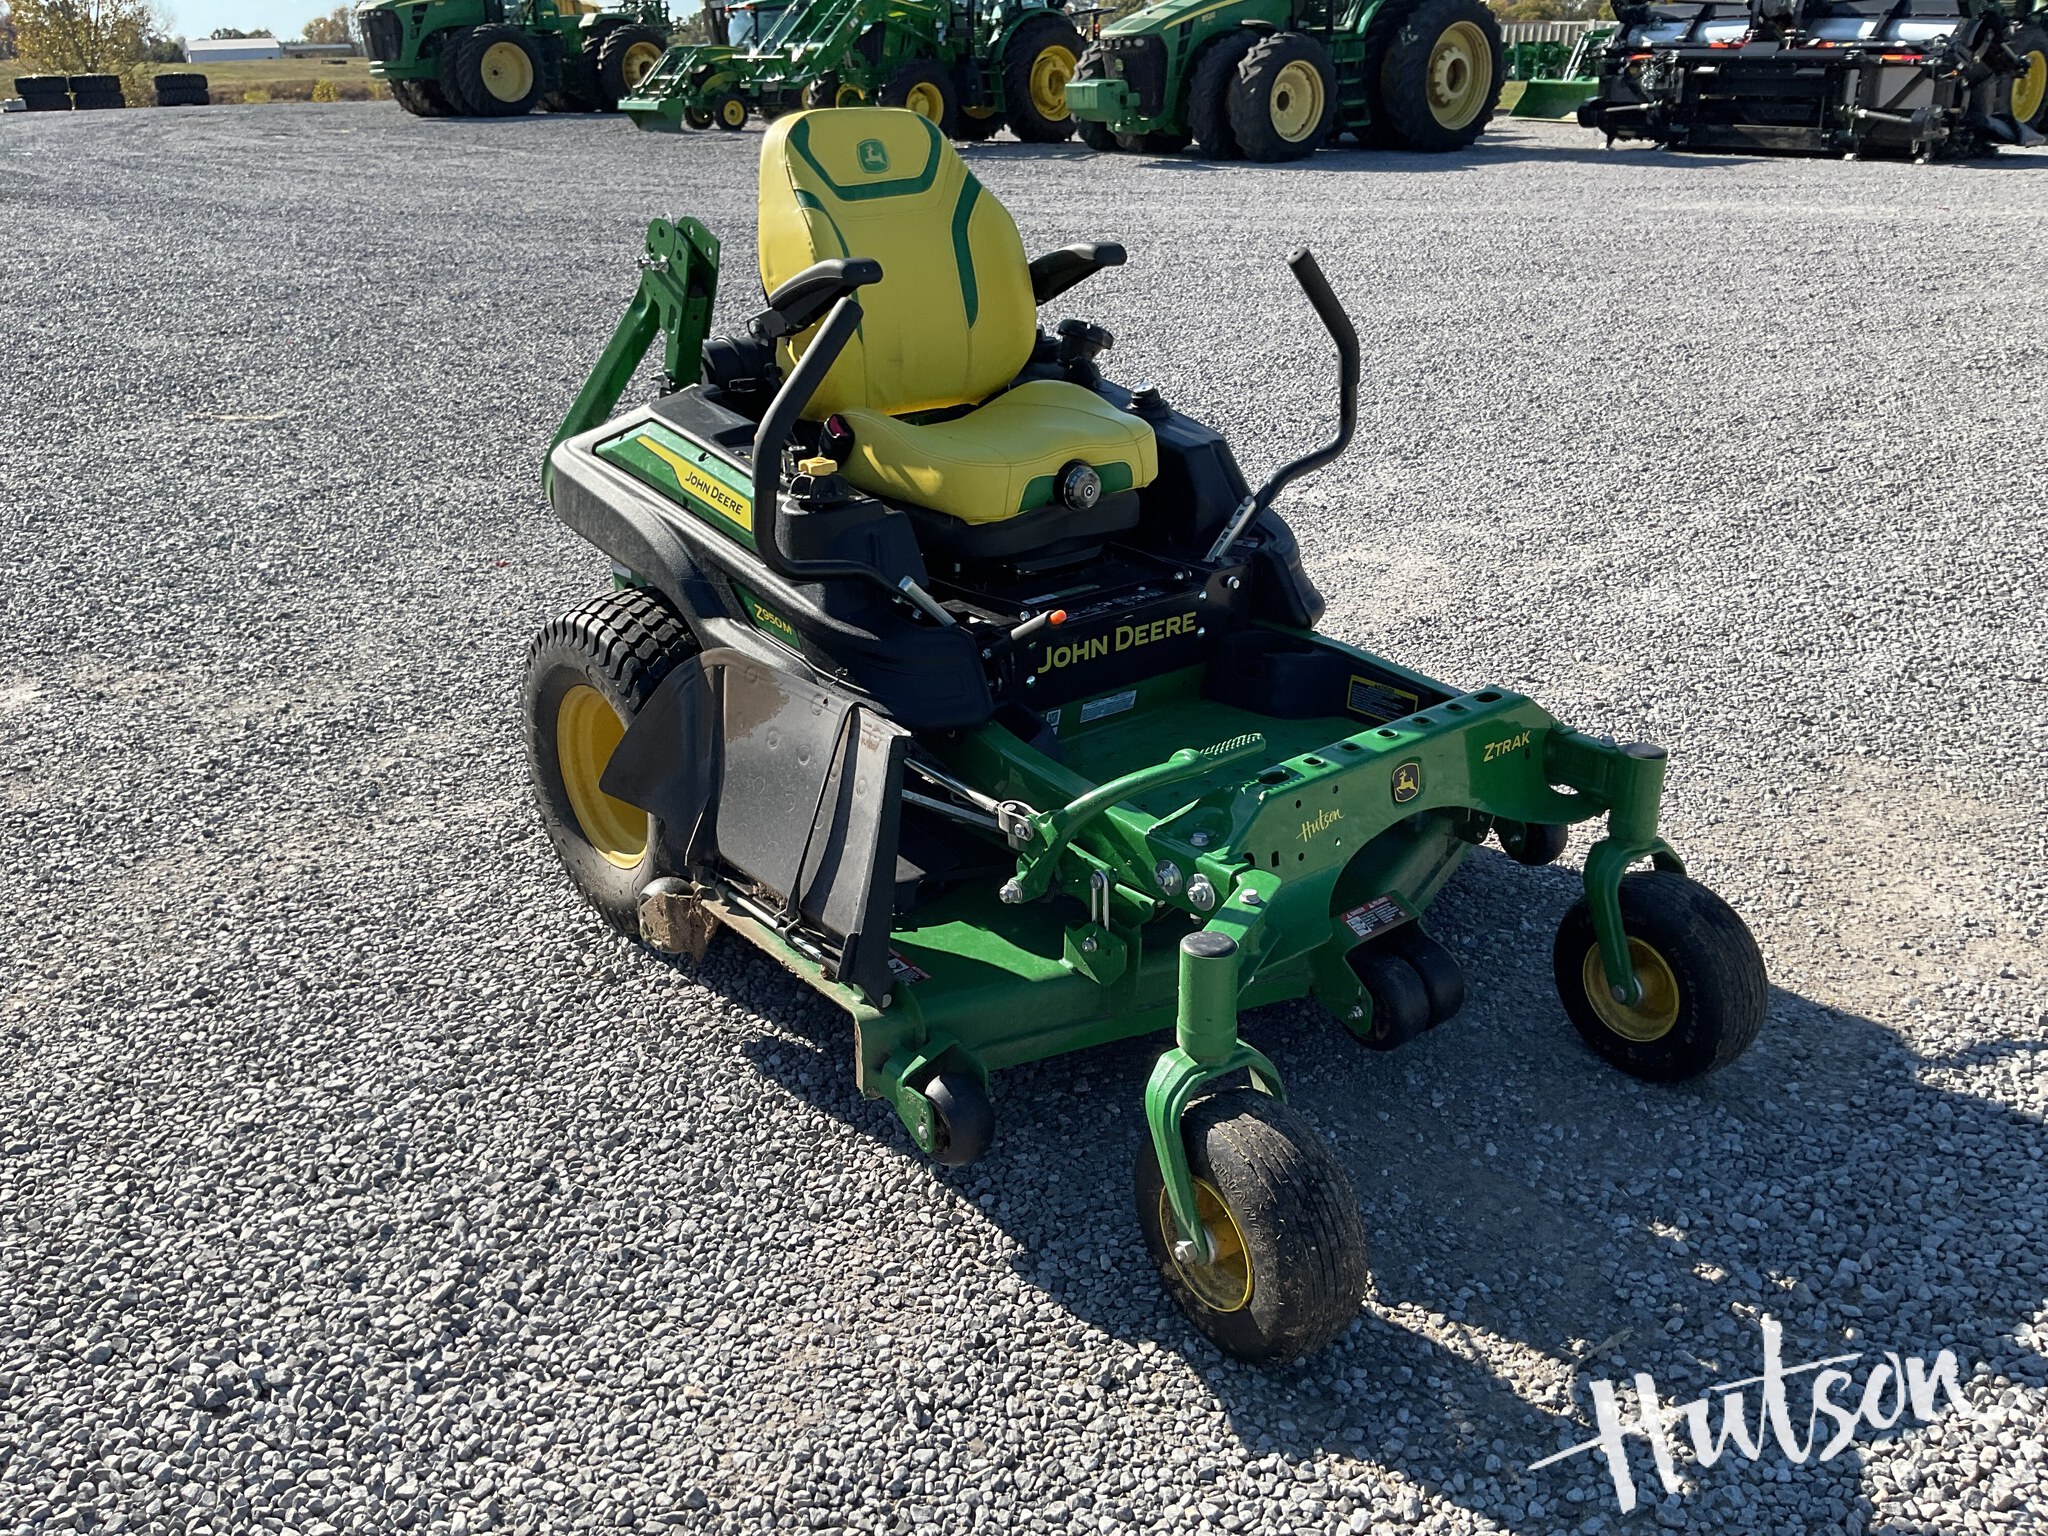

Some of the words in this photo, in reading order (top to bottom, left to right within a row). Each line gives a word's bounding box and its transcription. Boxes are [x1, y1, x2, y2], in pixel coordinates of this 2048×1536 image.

[685, 471, 710, 495] JOHN
[710, 484, 744, 515] DEERE
[753, 603, 793, 636] Z950M
[1037, 635, 1108, 674] JOHN
[1115, 611, 1197, 652] DEERE
[1483, 730, 1531, 763] ZTRAK
[1295, 808, 1346, 843] Hutson
